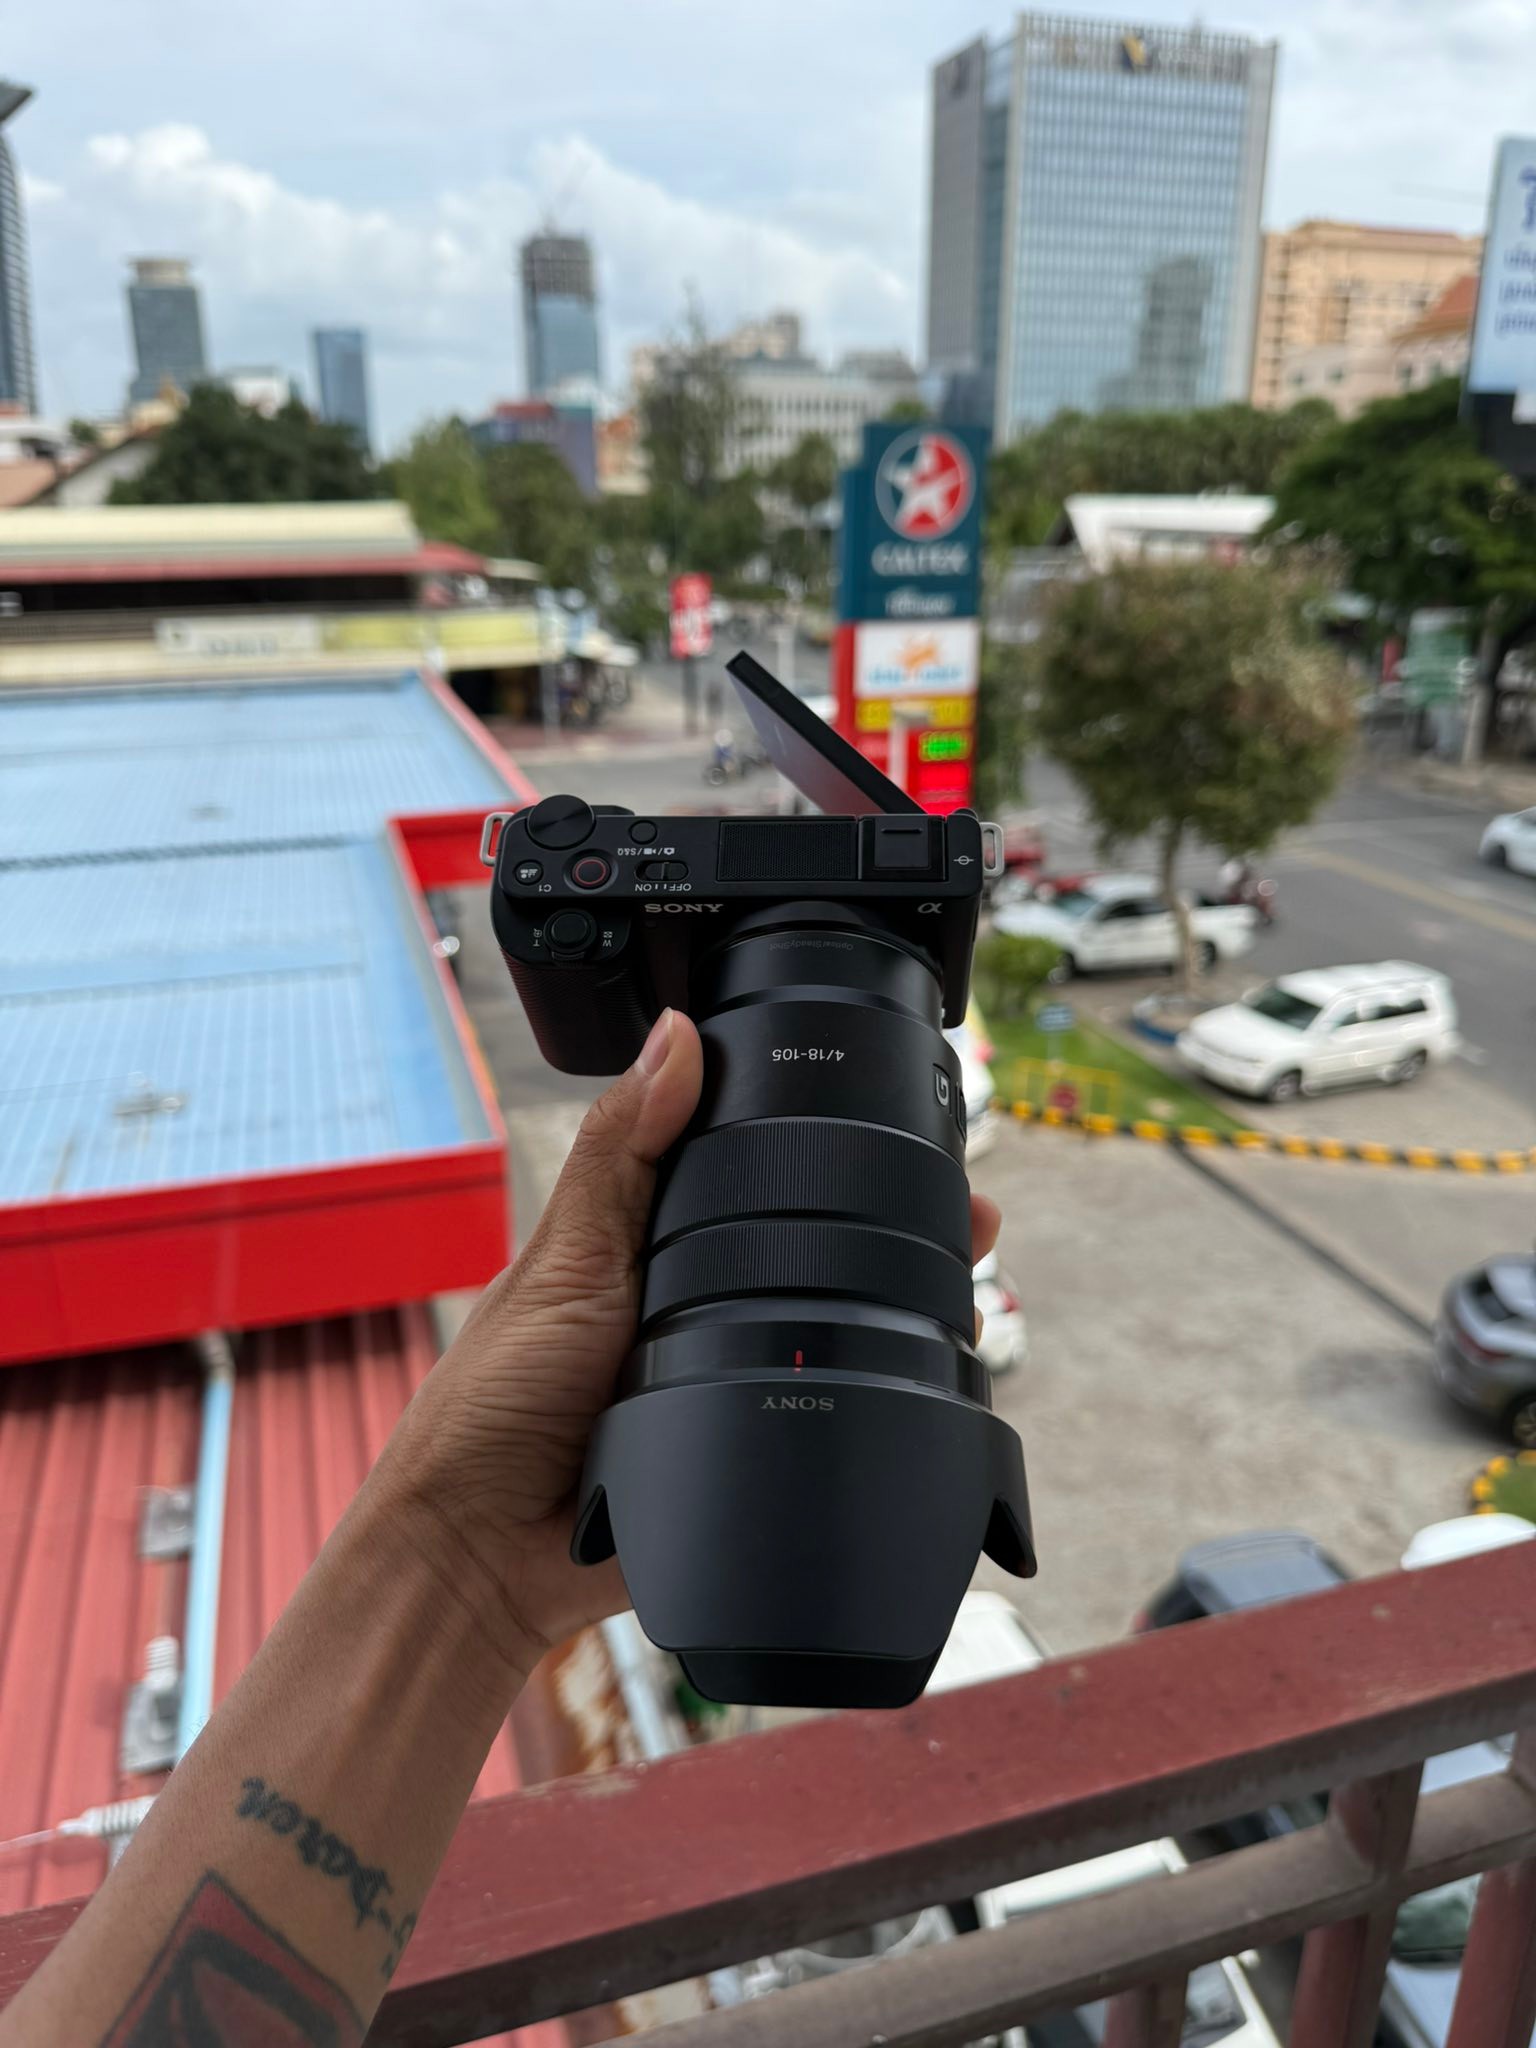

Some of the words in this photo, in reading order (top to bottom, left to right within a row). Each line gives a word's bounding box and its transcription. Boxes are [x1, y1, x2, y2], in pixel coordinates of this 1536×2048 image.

[538, 883, 552, 893] C1
[635, 883, 652, 892] ON
[669, 883, 692, 892] OFF
[644, 903, 724, 913] SONY
[772, 1048, 845, 1062] 4/18-105
[935, 1072, 949, 1107] G
[760, 1396, 835, 1411] SONY
